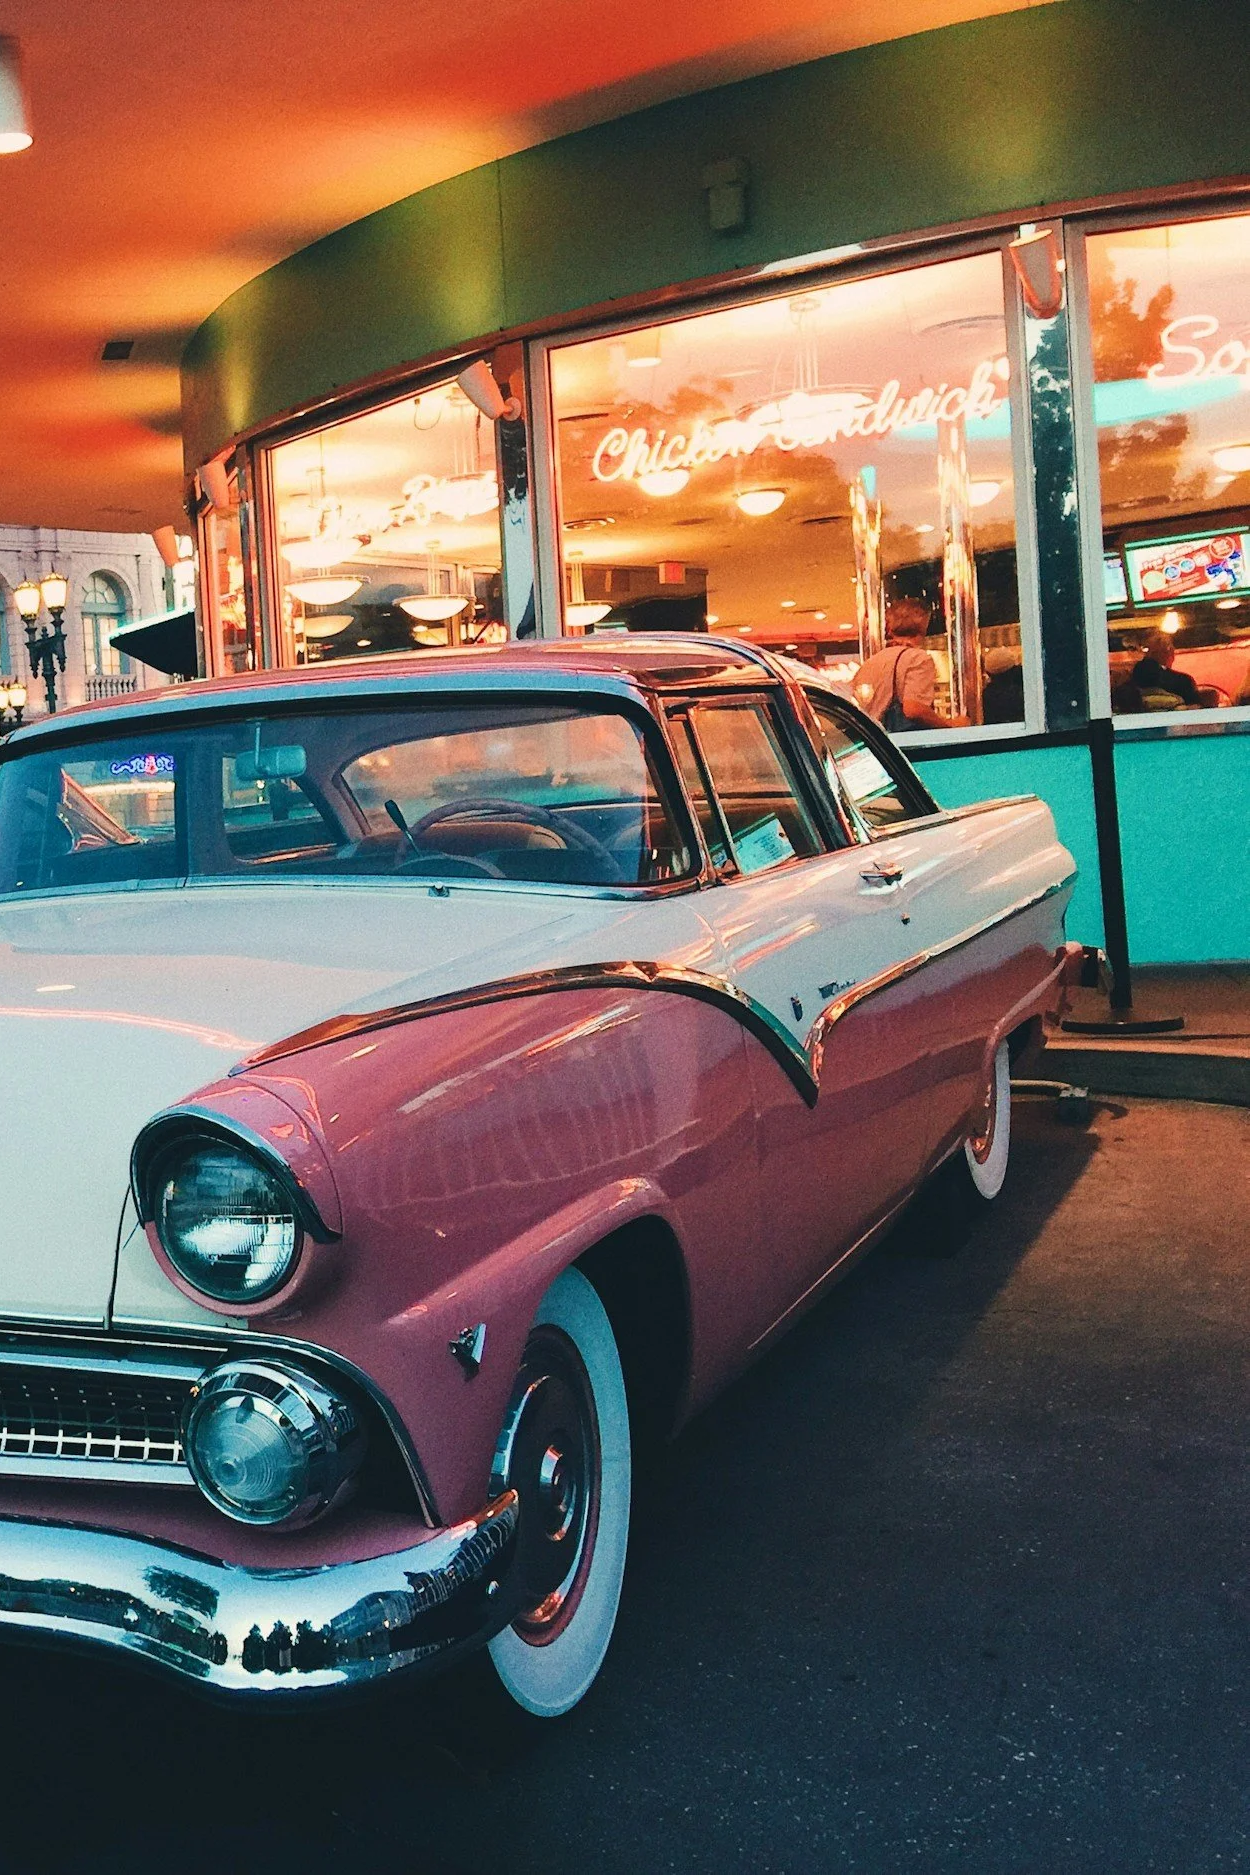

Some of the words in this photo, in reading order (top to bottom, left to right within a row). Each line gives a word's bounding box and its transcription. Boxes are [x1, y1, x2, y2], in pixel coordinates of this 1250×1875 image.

[1147, 314, 1250, 390] So
[592, 416, 766, 482] Chicken
[772, 361, 1002, 452] Sandwich
